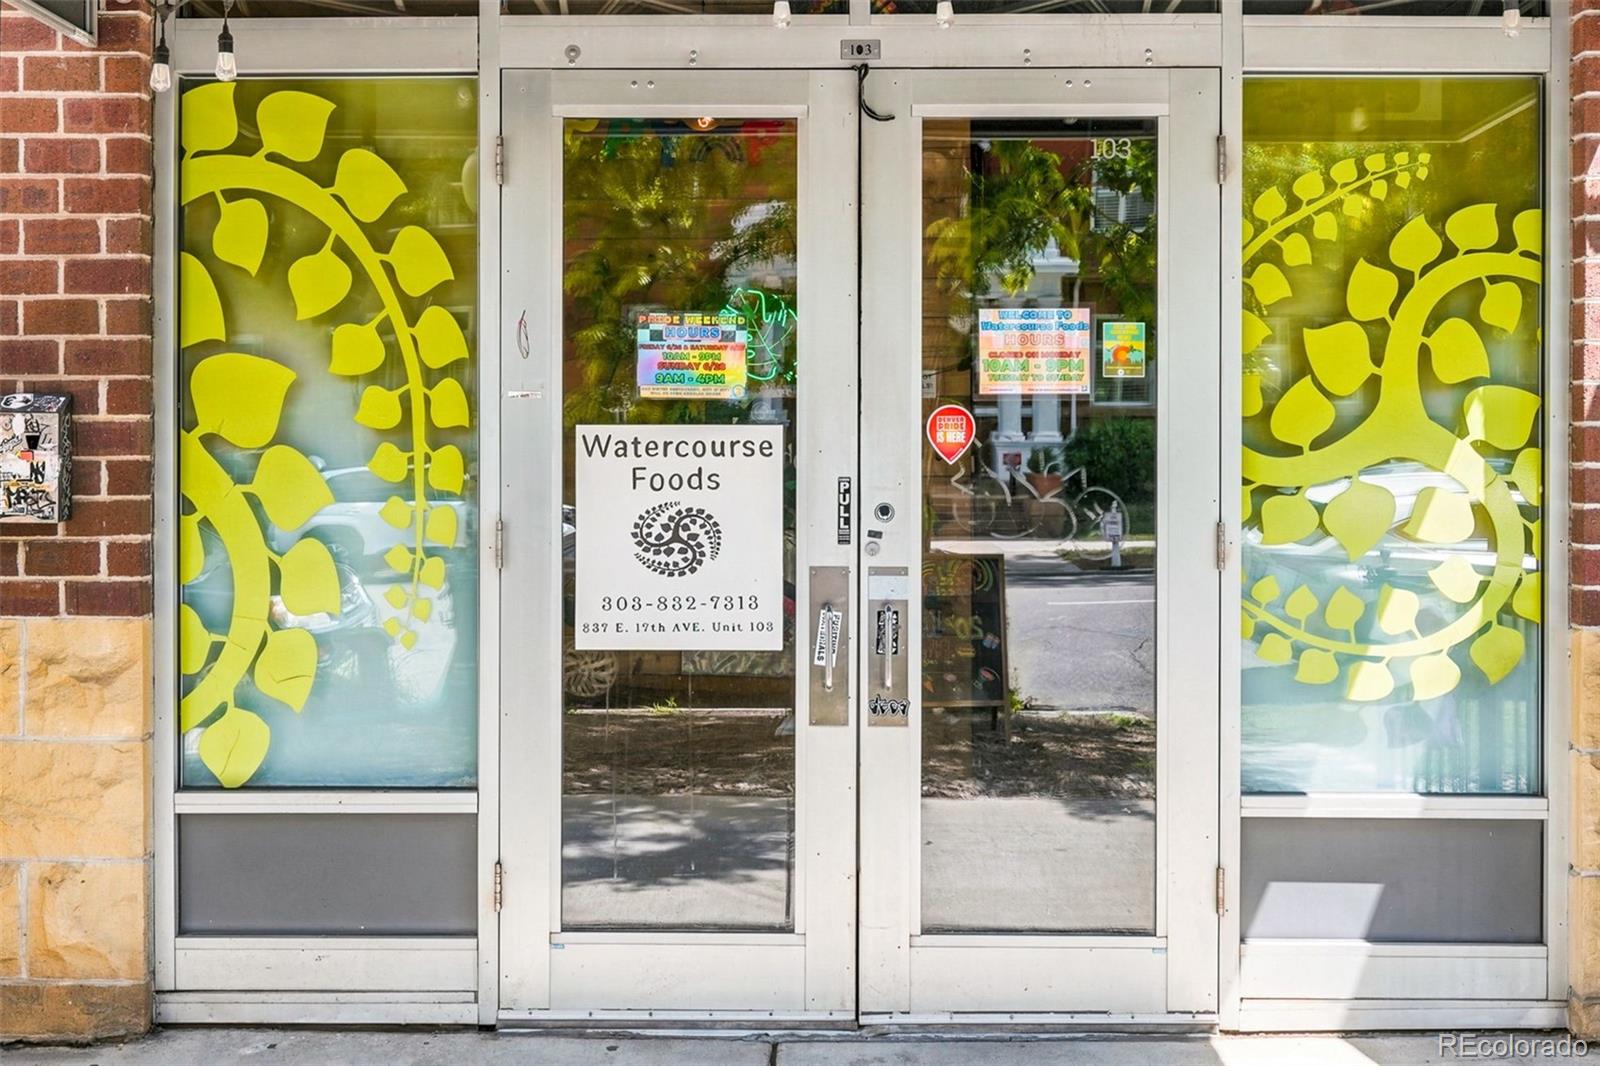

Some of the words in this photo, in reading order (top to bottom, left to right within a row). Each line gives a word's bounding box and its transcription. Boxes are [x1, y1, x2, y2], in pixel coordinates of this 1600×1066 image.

[850, 44, 872, 56] 103
[1090, 138, 1131, 160] 103
[638, 315, 680, 325] PRIDE
[684, 315, 746, 325] WEEKEND
[998, 310, 1055, 320] WELCOME
[1056, 310, 1073, 320] TO
[981, 321, 1053, 331] Watercourse
[1055, 321, 1090, 331] Foods
[664, 327, 720, 338] HOURS
[1004, 333, 1066, 346] HOURS
[662, 352, 690, 360] 10AM
[988, 351, 1024, 359] CLOSED
[1025, 351, 1039, 359] ON
[1040, 351, 1082, 359] MONDAY
[657, 361, 701, 370] SUNDAY
[982, 359, 1030, 372] 10AM
[1045, 359, 1085, 372] 9PM
[655, 373, 686, 384] 9AM
[696, 373, 726, 384] 4PM
[936, 431, 945, 443] IS
[946, 431, 966, 443] HERE
[582, 434, 774, 458] Watercourse
[632, 466, 721, 491] Foods
[839, 482, 850, 530] PULL
[602, 596, 759, 611] 303-832-7313
[582, 623, 608, 633] 837
[616, 623, 629, 633] E.
[635, 623, 666, 633] 17th
[672, 622, 705, 633] AVE.
[712, 622, 743, 632] Unit
[750, 622, 774, 632] 103
